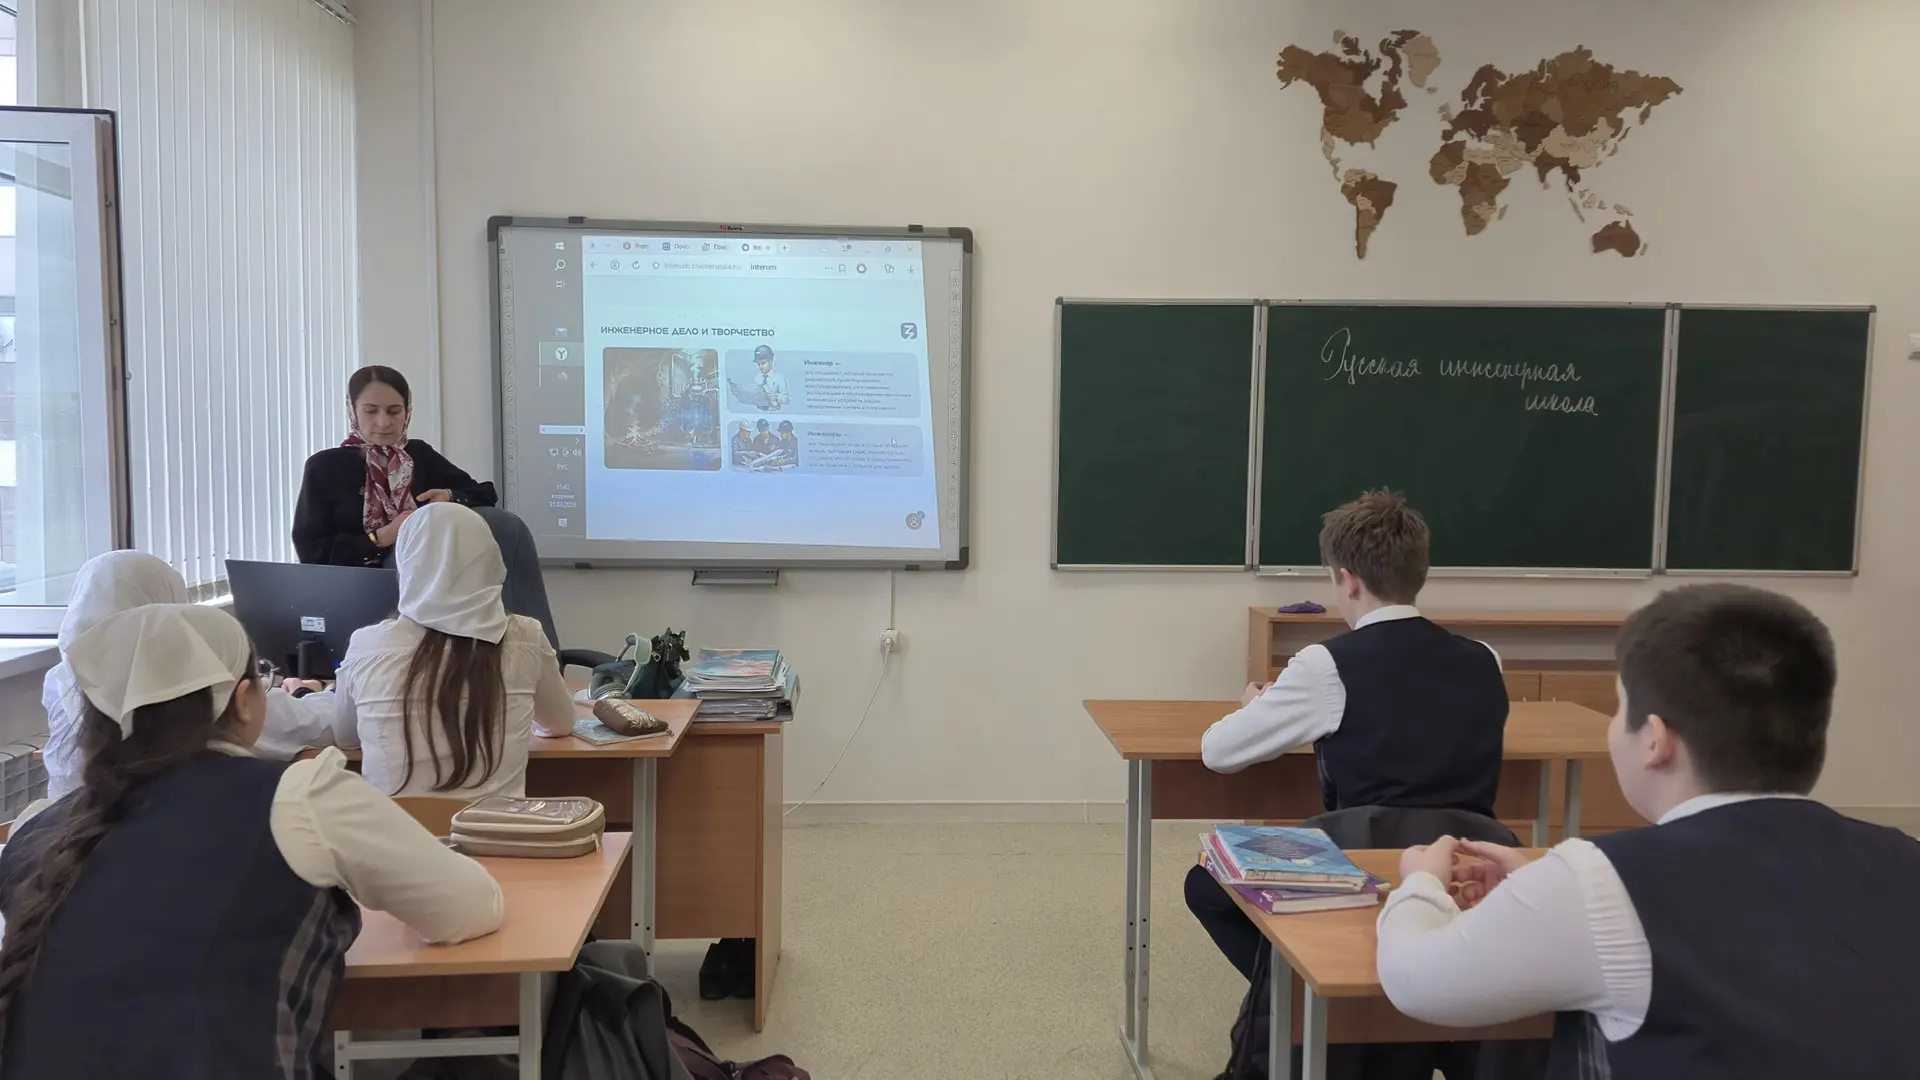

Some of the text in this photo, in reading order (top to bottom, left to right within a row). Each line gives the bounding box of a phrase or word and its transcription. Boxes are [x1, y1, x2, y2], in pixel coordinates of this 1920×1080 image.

[600, 326, 775, 338] ИНЖЕНЕРНОЕ ДЕЛО И ТВОРЧЕСТВО
[1321, 328, 1582, 390] Русская инженерная
[1524, 394, 1599, 416] школа
